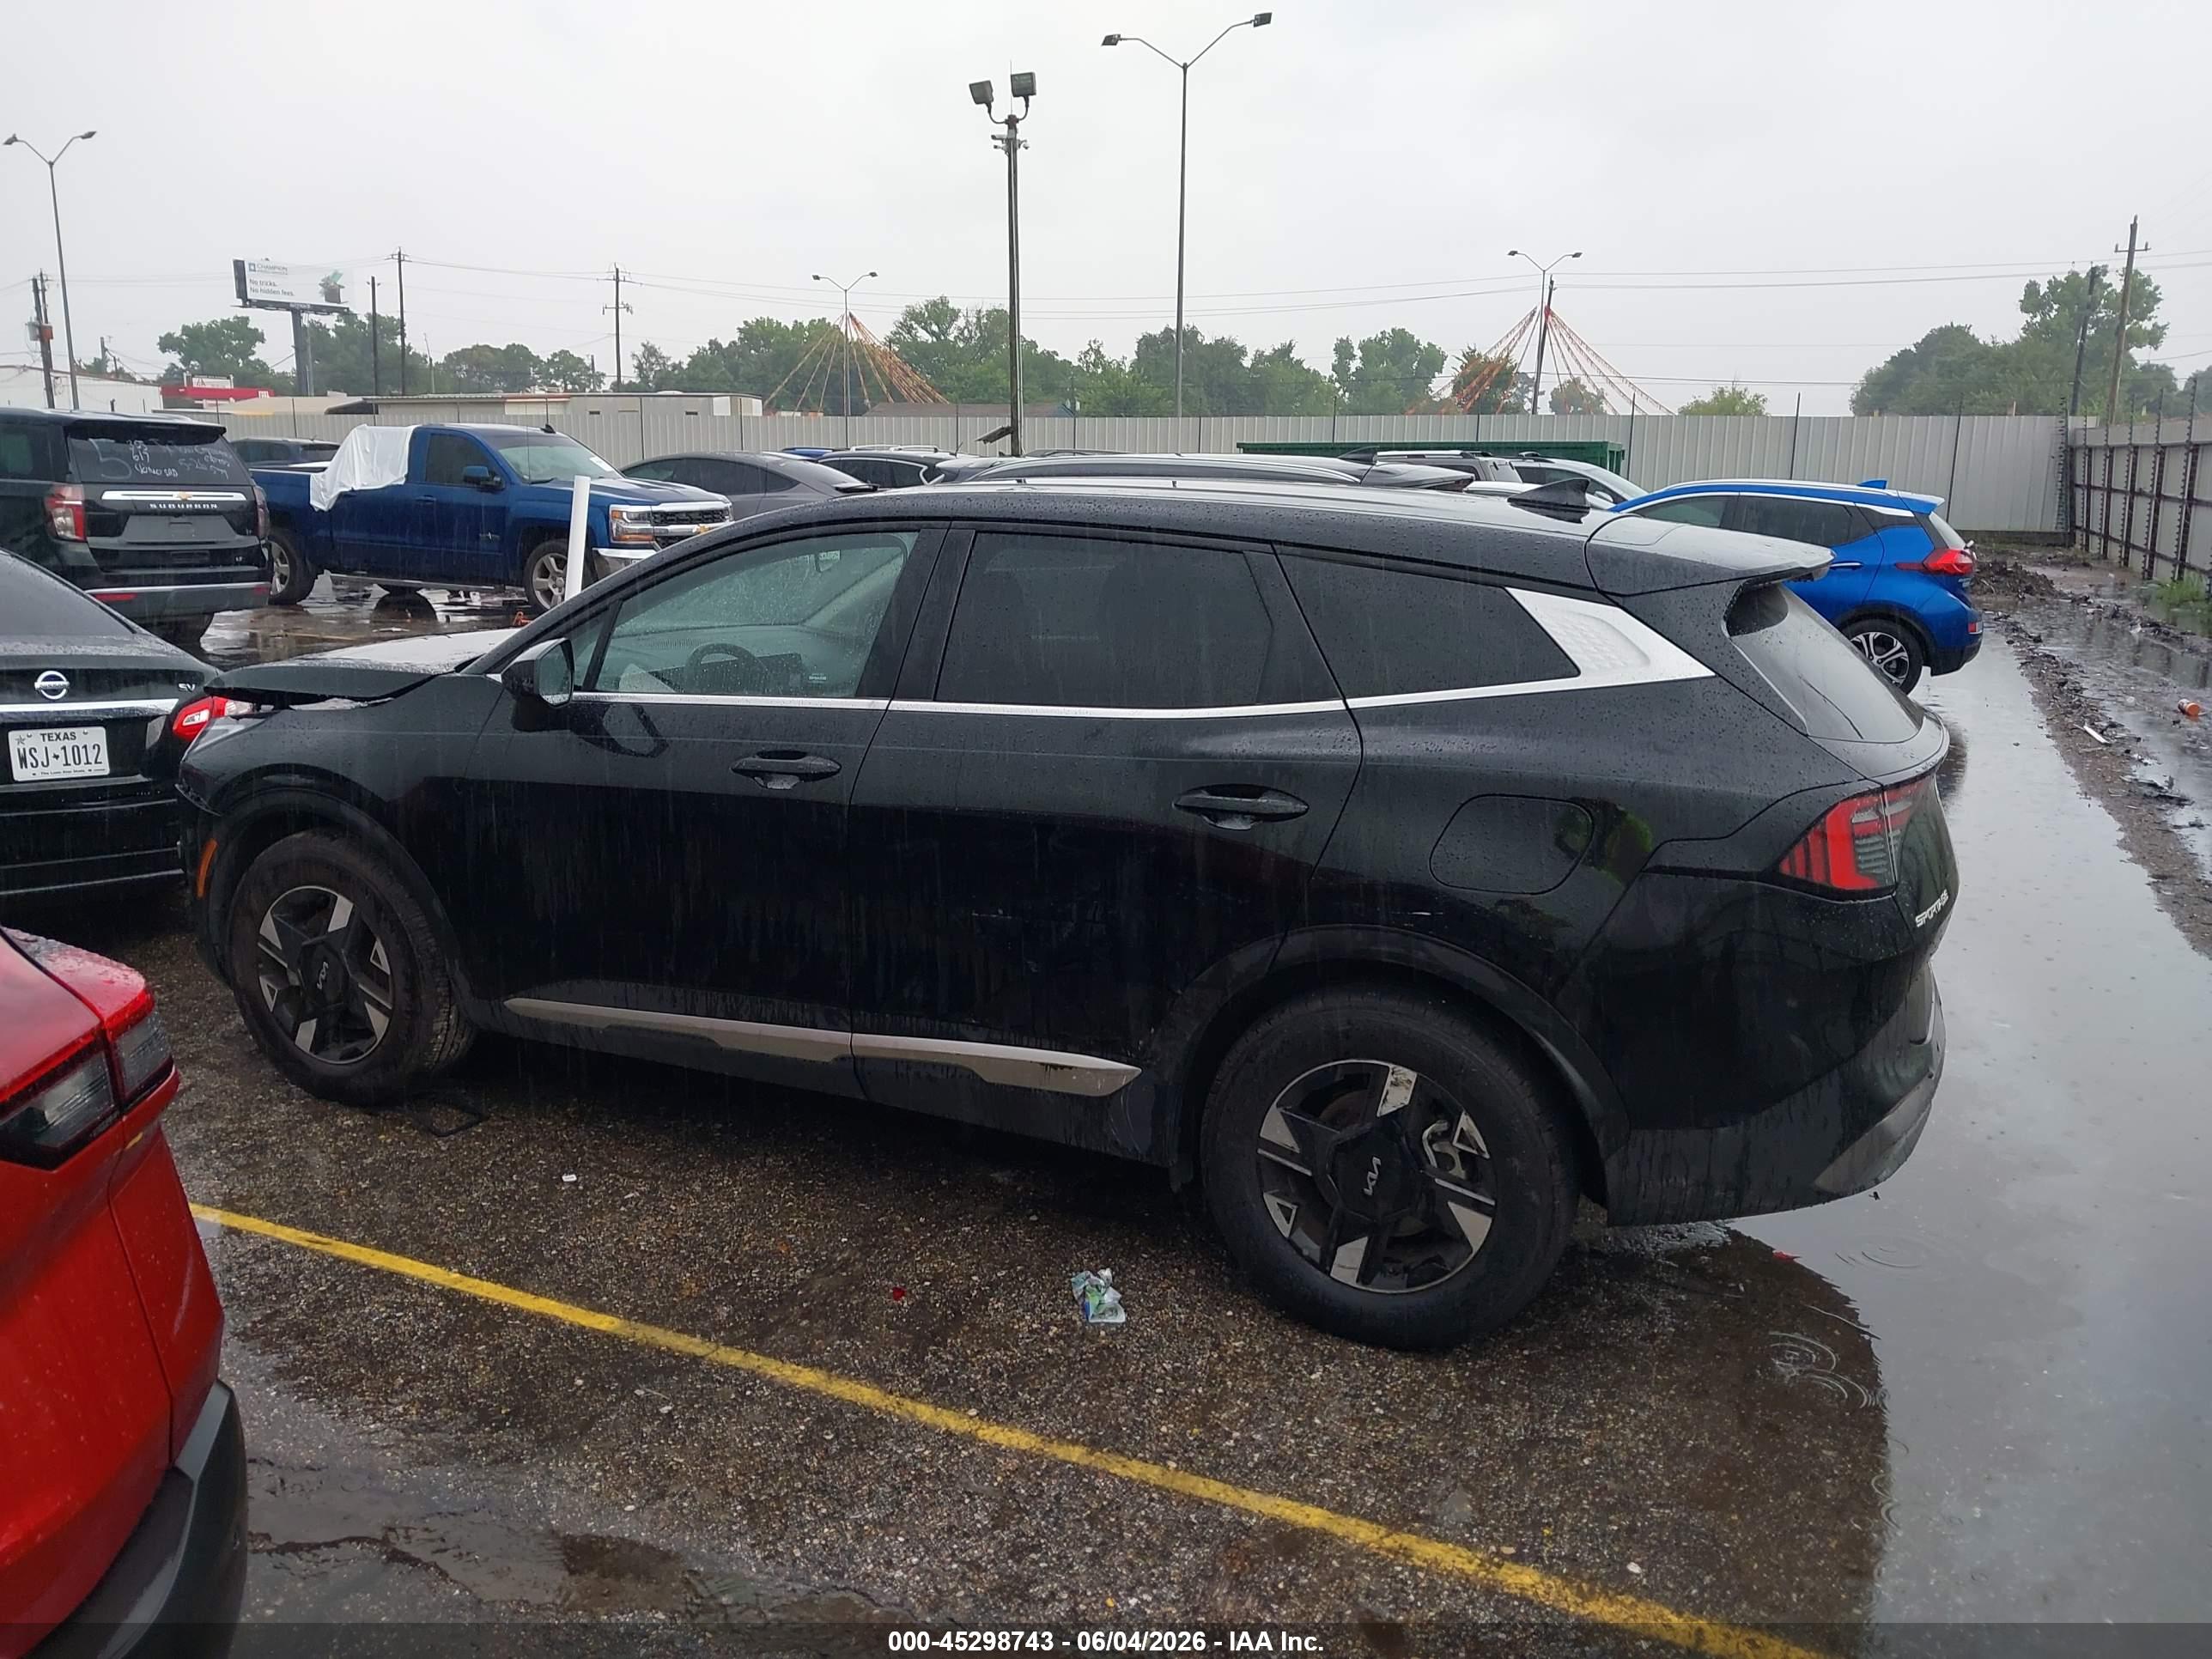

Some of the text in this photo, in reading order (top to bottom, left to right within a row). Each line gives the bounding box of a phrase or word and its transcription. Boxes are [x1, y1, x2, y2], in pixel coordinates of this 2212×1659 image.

[179, 683, 196, 693] SV
[40, 732, 76, 742] TEXAS
[17, 744, 102, 769] WSJ 1012
